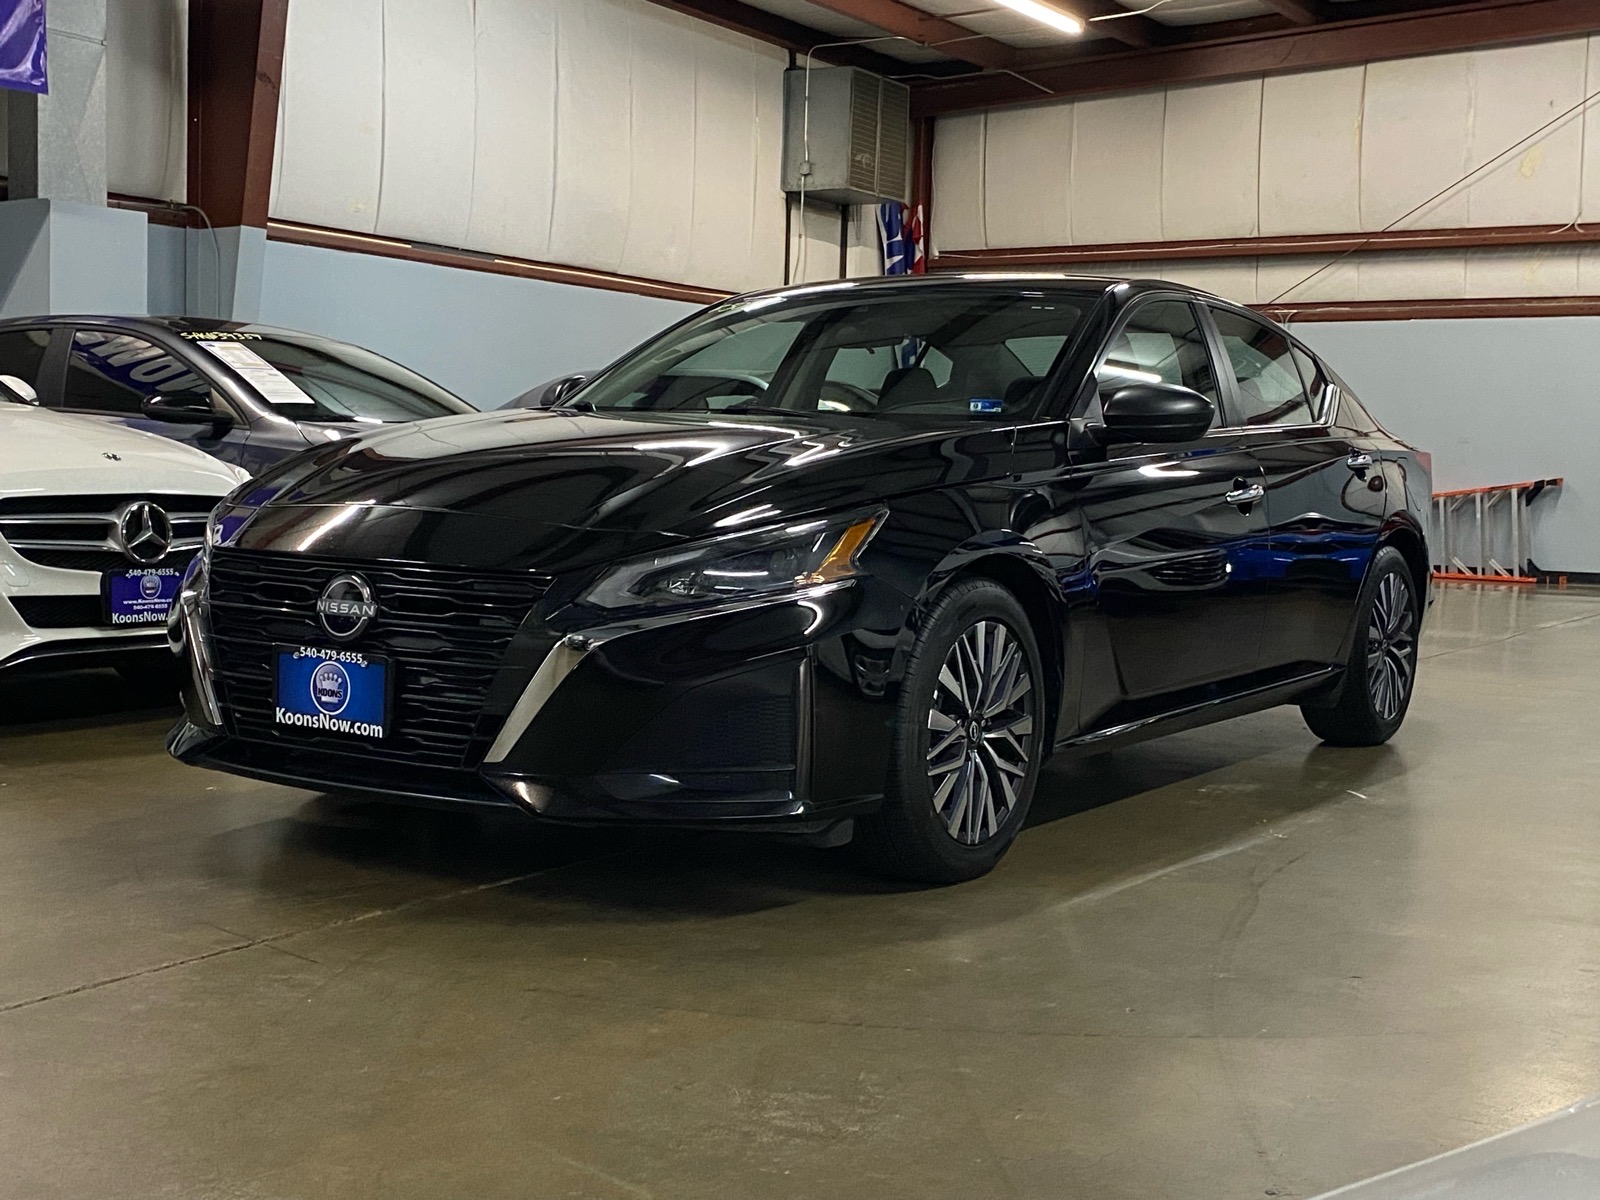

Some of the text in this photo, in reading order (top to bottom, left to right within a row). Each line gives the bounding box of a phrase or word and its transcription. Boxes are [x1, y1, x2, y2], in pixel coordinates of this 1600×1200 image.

[128, 568, 174, 577] 540-479-6555
[317, 601, 375, 615] NISSAN
[300, 647, 363, 664] 540-479-6555
[318, 688, 342, 698] KOONS
[275, 707, 383, 738] KoonsNow.com
